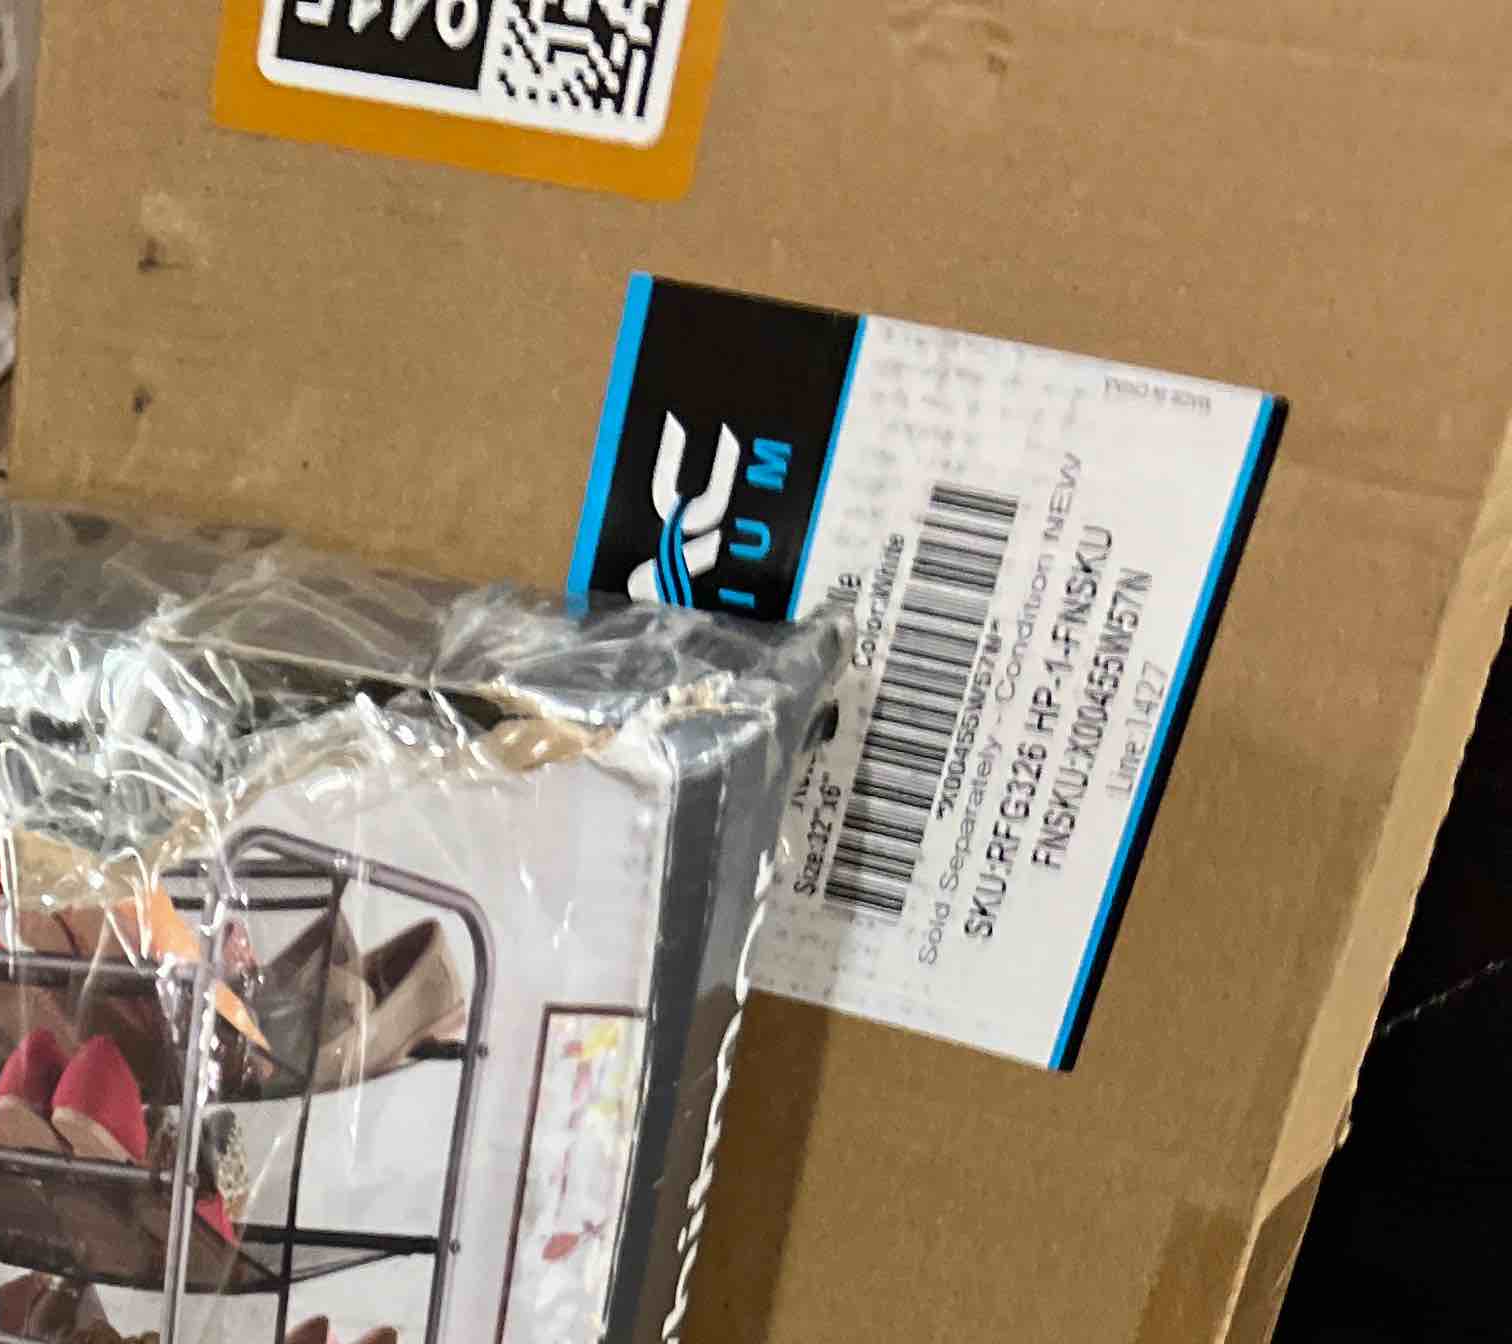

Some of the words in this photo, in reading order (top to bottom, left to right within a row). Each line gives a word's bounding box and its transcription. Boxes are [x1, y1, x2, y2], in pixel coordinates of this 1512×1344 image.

[917, 900, 951, 966] Sold
[939, 734, 1004, 893] Separately
[994, 553, 1056, 703] Condition
[1043, 451, 1083, 543] NEW
[1023, 524, 1114, 737] HP-1-FNSKU
